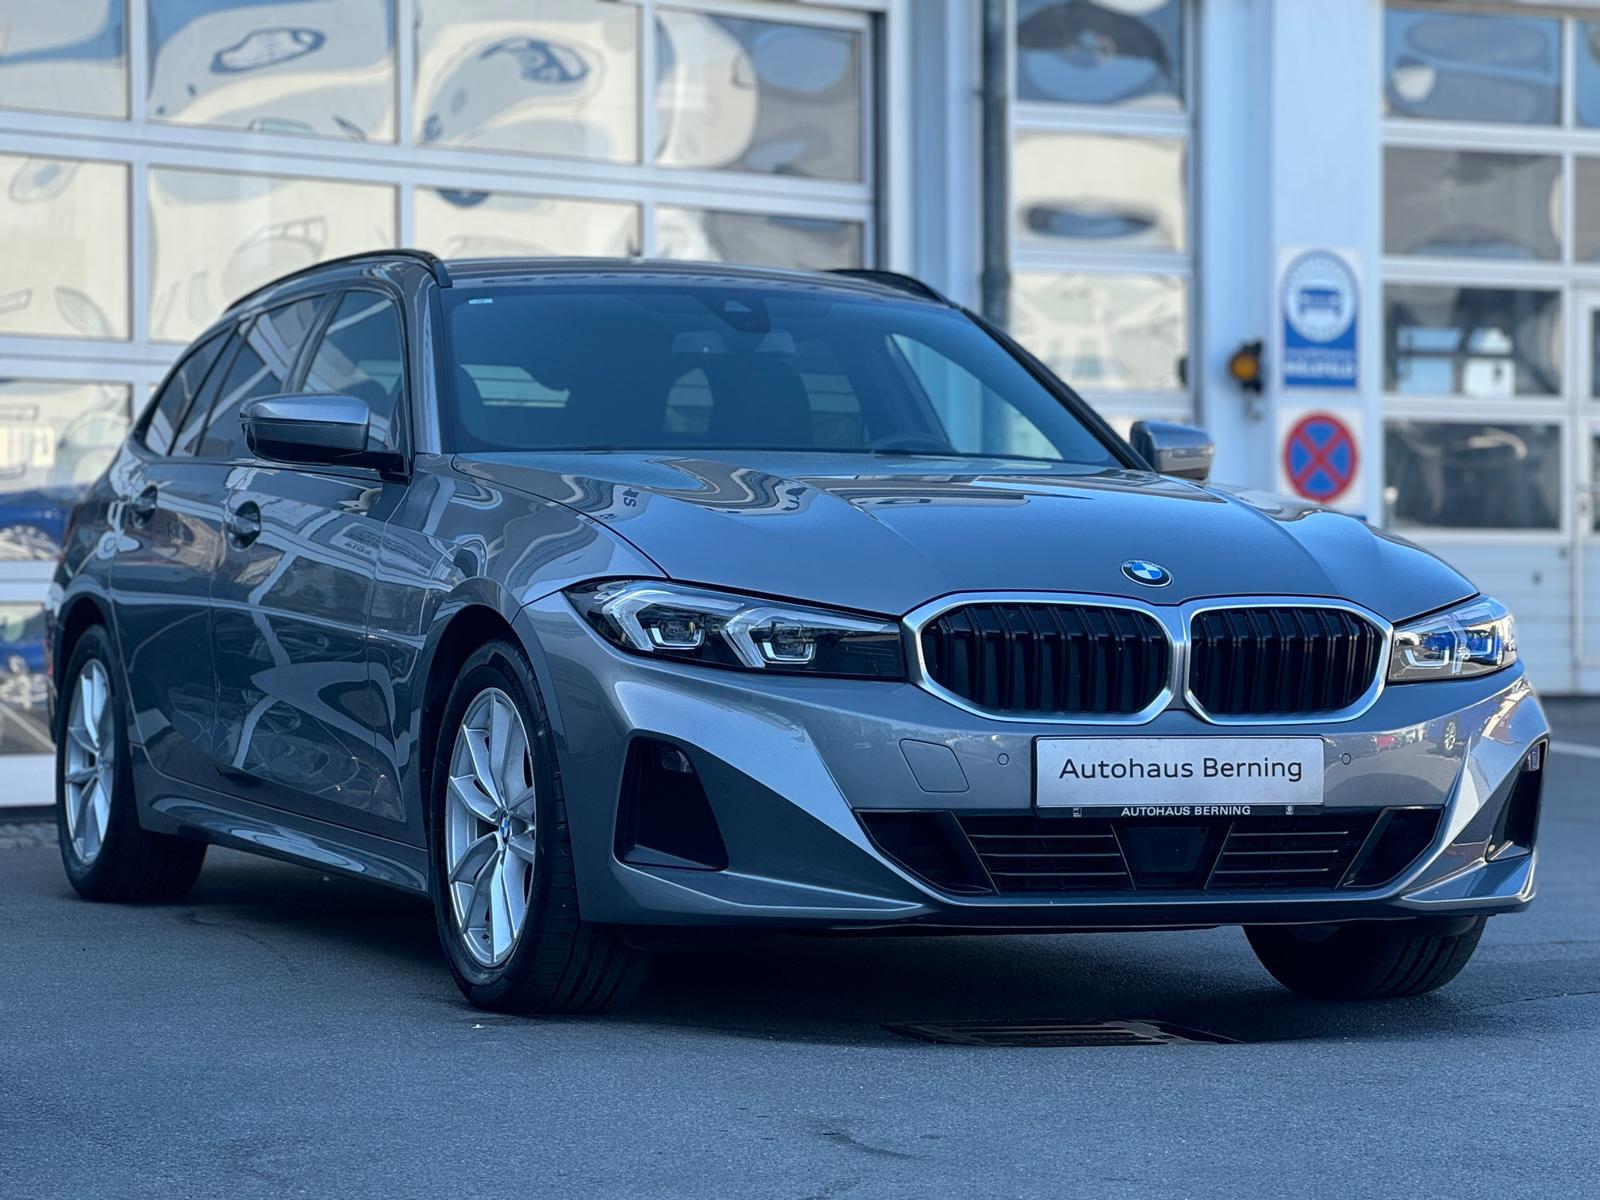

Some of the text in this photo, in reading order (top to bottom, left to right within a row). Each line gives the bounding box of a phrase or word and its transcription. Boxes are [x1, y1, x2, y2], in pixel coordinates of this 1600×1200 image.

[1059, 757, 1302, 783] Autohaus Berning
[1121, 805, 1251, 817] AUTOHAUS BERNING
